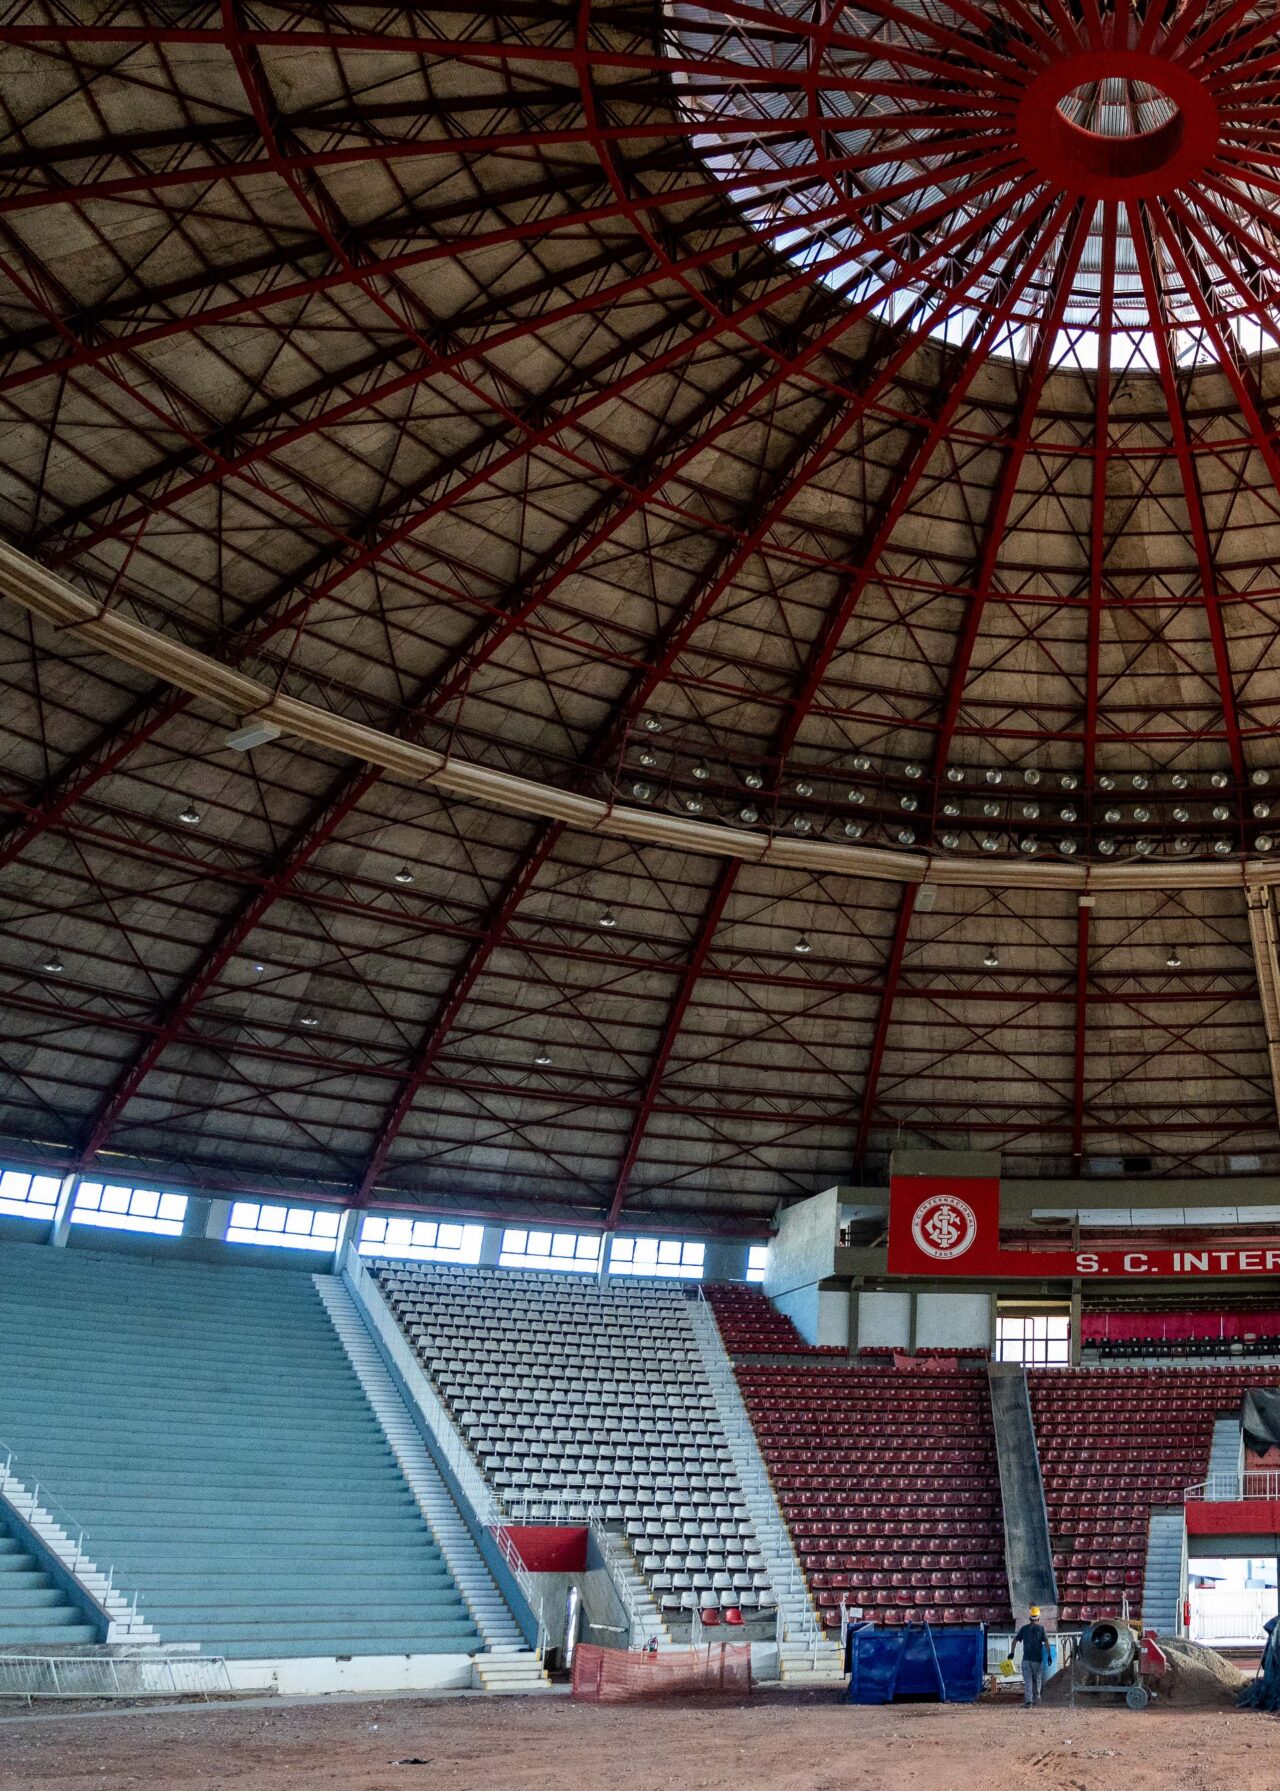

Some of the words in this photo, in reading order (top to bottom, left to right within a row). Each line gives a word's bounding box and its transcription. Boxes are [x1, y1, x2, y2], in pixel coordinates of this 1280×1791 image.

[920, 1198, 974, 1228] INTERNACIONAL
[1076, 1254, 1108, 1272] S.
[1124, 1253, 1158, 1272] C.
